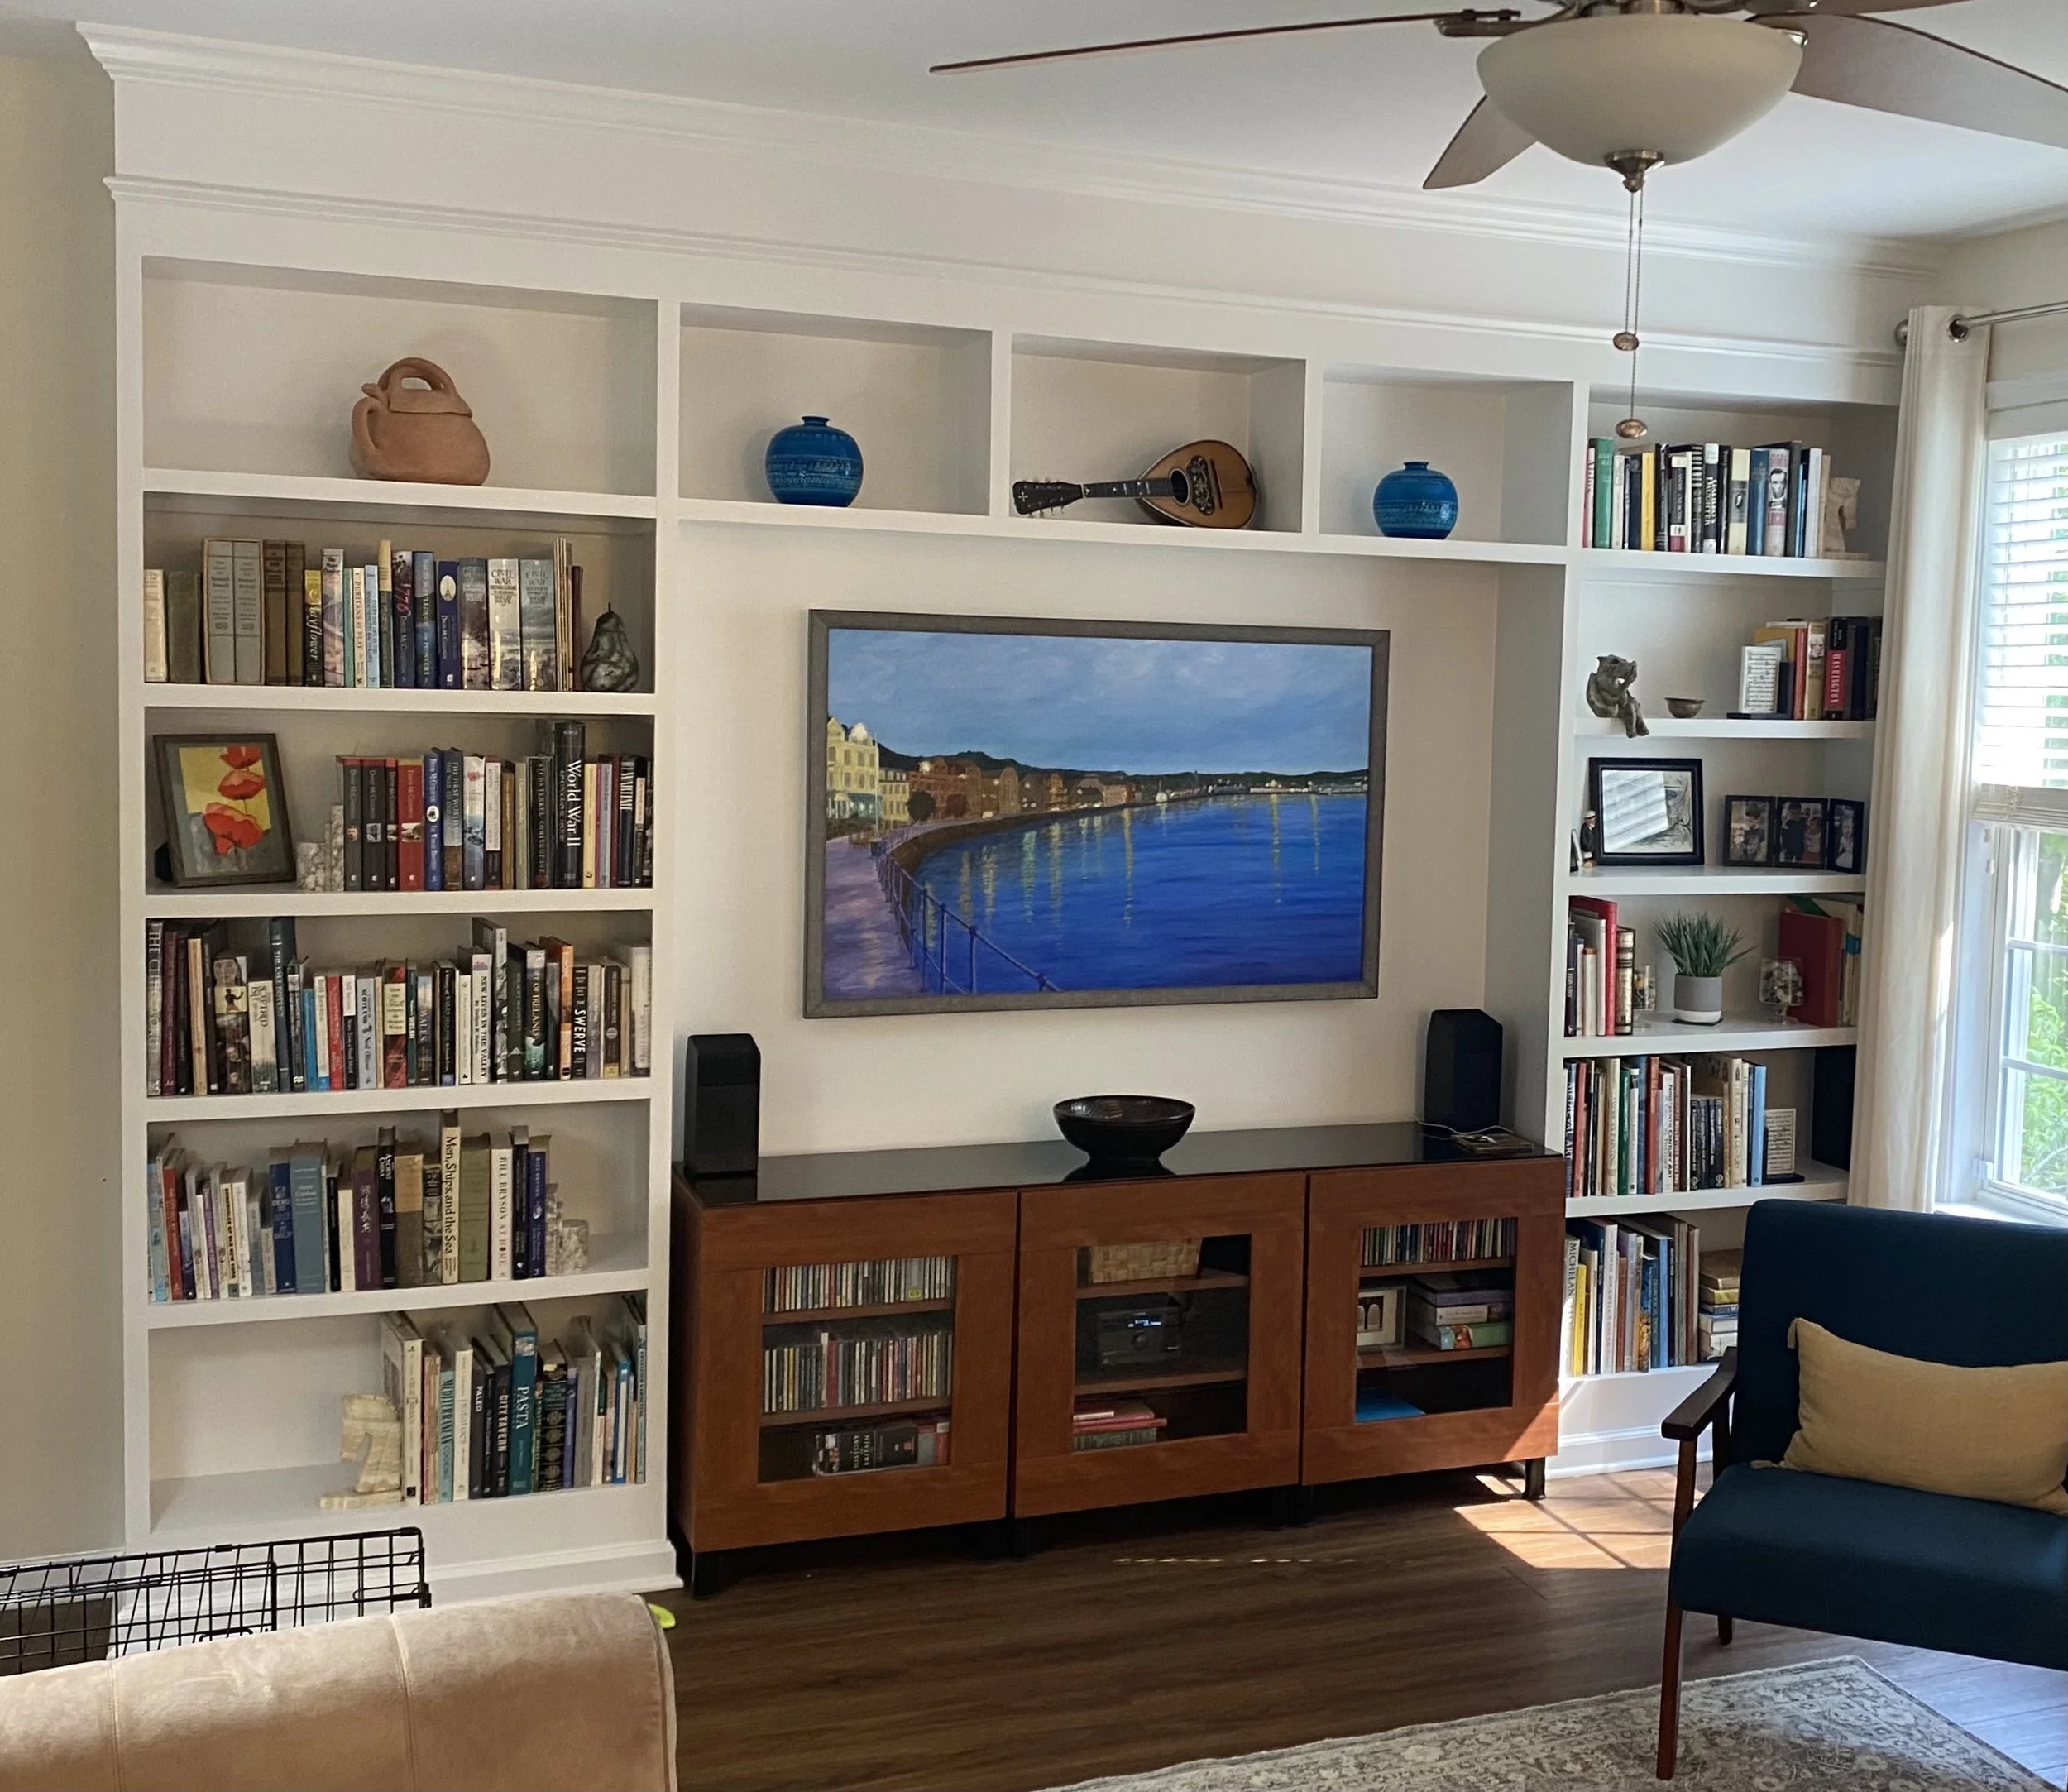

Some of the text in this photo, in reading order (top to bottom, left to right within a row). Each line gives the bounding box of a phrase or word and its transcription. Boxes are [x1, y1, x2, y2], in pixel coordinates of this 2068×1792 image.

[1704, 477, 1712, 525] DAUGHTER
[491, 569, 514, 578] CIVIL
[395, 583, 411, 616] 1776
[1830, 653, 1841, 703] WASHINGTON
[567, 759, 582, 846] World War II
[149, 932, 161, 952] THE
[532, 982, 539, 993] OF
[419, 1009, 427, 1042] WALES
[481, 1020, 488, 1028] IN
[532, 994, 541, 1037] IRELAND
[573, 1009, 586, 1053] SWERVE
[1566, 1082, 1575, 1138] MEDIEVAL
[445, 1136, 457, 1162] Men,
[499, 1157, 507, 1178] BILL
[444, 1194, 454, 1214] and
[499, 1181, 507, 1219] BRYSON
[444, 1216, 455, 1233] the
[499, 1224, 506, 1236] AT
[445, 1234, 456, 1254] Sea
[441, 1379, 453, 1444] MEDITERRANEAN
[475, 1385, 483, 1411] PALEO
[515, 1386, 529, 1430] PASTA
[457, 1398, 469, 1444] potatoes
[497, 1394, 509, 1452] CITY TAVERN
